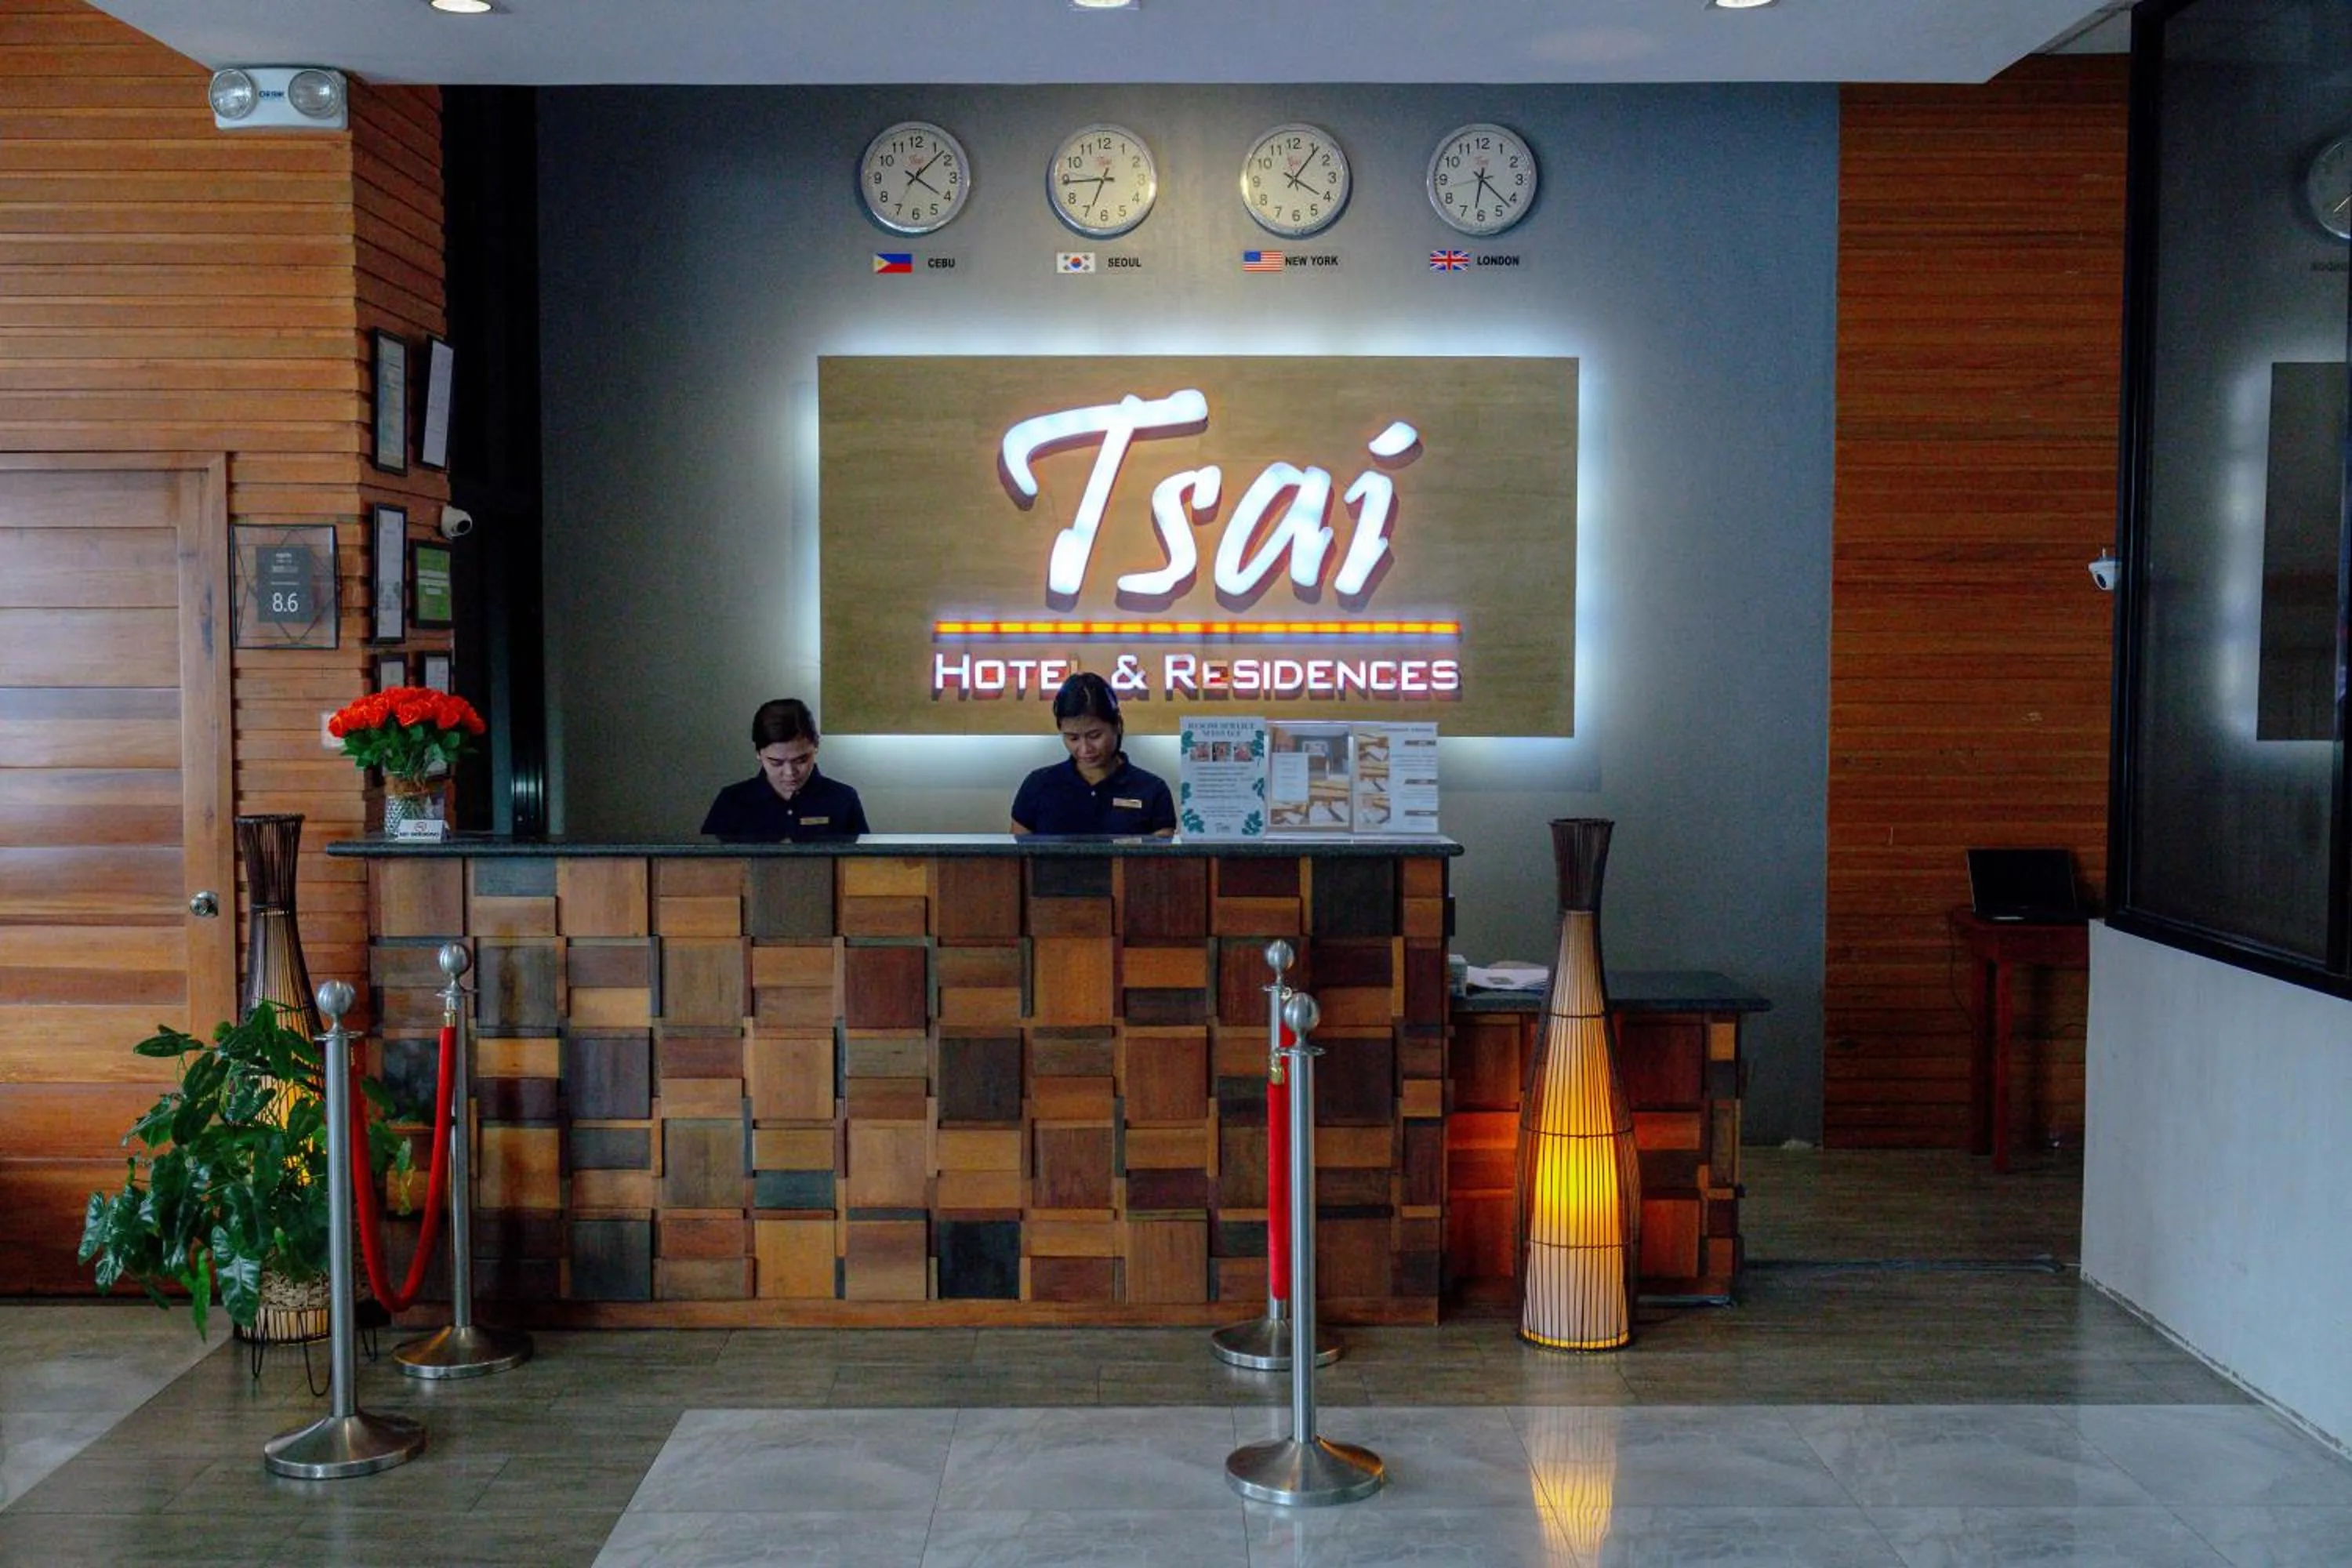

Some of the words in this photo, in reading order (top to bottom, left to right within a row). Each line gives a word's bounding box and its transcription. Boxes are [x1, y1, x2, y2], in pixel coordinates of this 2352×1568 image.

[892, 142, 904, 154] 11
[909, 136, 924, 148] 12
[1098, 137, 1112, 150] 12
[1287, 137, 1302, 150] 12
[1475, 137, 1490, 150] 12
[1080, 143, 1092, 155] 11
[1270, 143, 1282, 156] 11
[1458, 143, 1470, 154] 11
[880, 154, 895, 167] 10
[943, 154, 953, 166] 2
[1067, 156, 1083, 169] 10
[1132, 155, 1141, 168] 2
[1258, 158, 1272, 170] 10
[1321, 154, 1330, 166] 2
[1445, 156, 1460, 168] 10
[1509, 156, 1519, 168] 2
[874, 172, 882, 184] 9
[949, 171, 957, 184] 3
[1062, 173, 1070, 185] 9
[1138, 173, 1145, 186] 3
[1252, 176, 1261, 187] 9
[1328, 171, 1337, 183] 3
[1439, 173, 1448, 186] 9
[1515, 173, 1523, 186] 3
[880, 191, 888, 203] 8
[944, 190, 951, 201] 4
[1068, 192, 1076, 205] 8
[1132, 191, 1140, 204] 4
[1260, 194, 1268, 205] 8
[1323, 191, 1331, 202] 4
[1445, 191, 1453, 205] 8
[1509, 191, 1517, 203] 4
[894, 203, 902, 216] 7
[912, 208, 920, 220] 6
[930, 203, 938, 215] 5
[1083, 205, 1091, 218] 7
[1100, 209, 1109, 221] 6
[1118, 205, 1127, 217] 5
[1274, 206, 1282, 217] 7
[1292, 209, 1301, 221] 6
[1310, 203, 1317, 216] 5
[1459, 205, 1468, 217] 7
[1495, 205, 1503, 217] 5
[1476, 209, 1485, 222] 6
[927, 258, 956, 268] CEBU
[1108, 257, 1142, 267] SEOUL
[1285, 256, 1307, 266] NEW
[1311, 256, 1338, 266] YORK
[1477, 256, 1519, 266] LONDON
[1001, 389, 1419, 601] Tsai
[272, 592, 299, 612] 8.6
[1110, 654, 1148, 691] &
[1163, 653, 1460, 691] RESIDENCES
